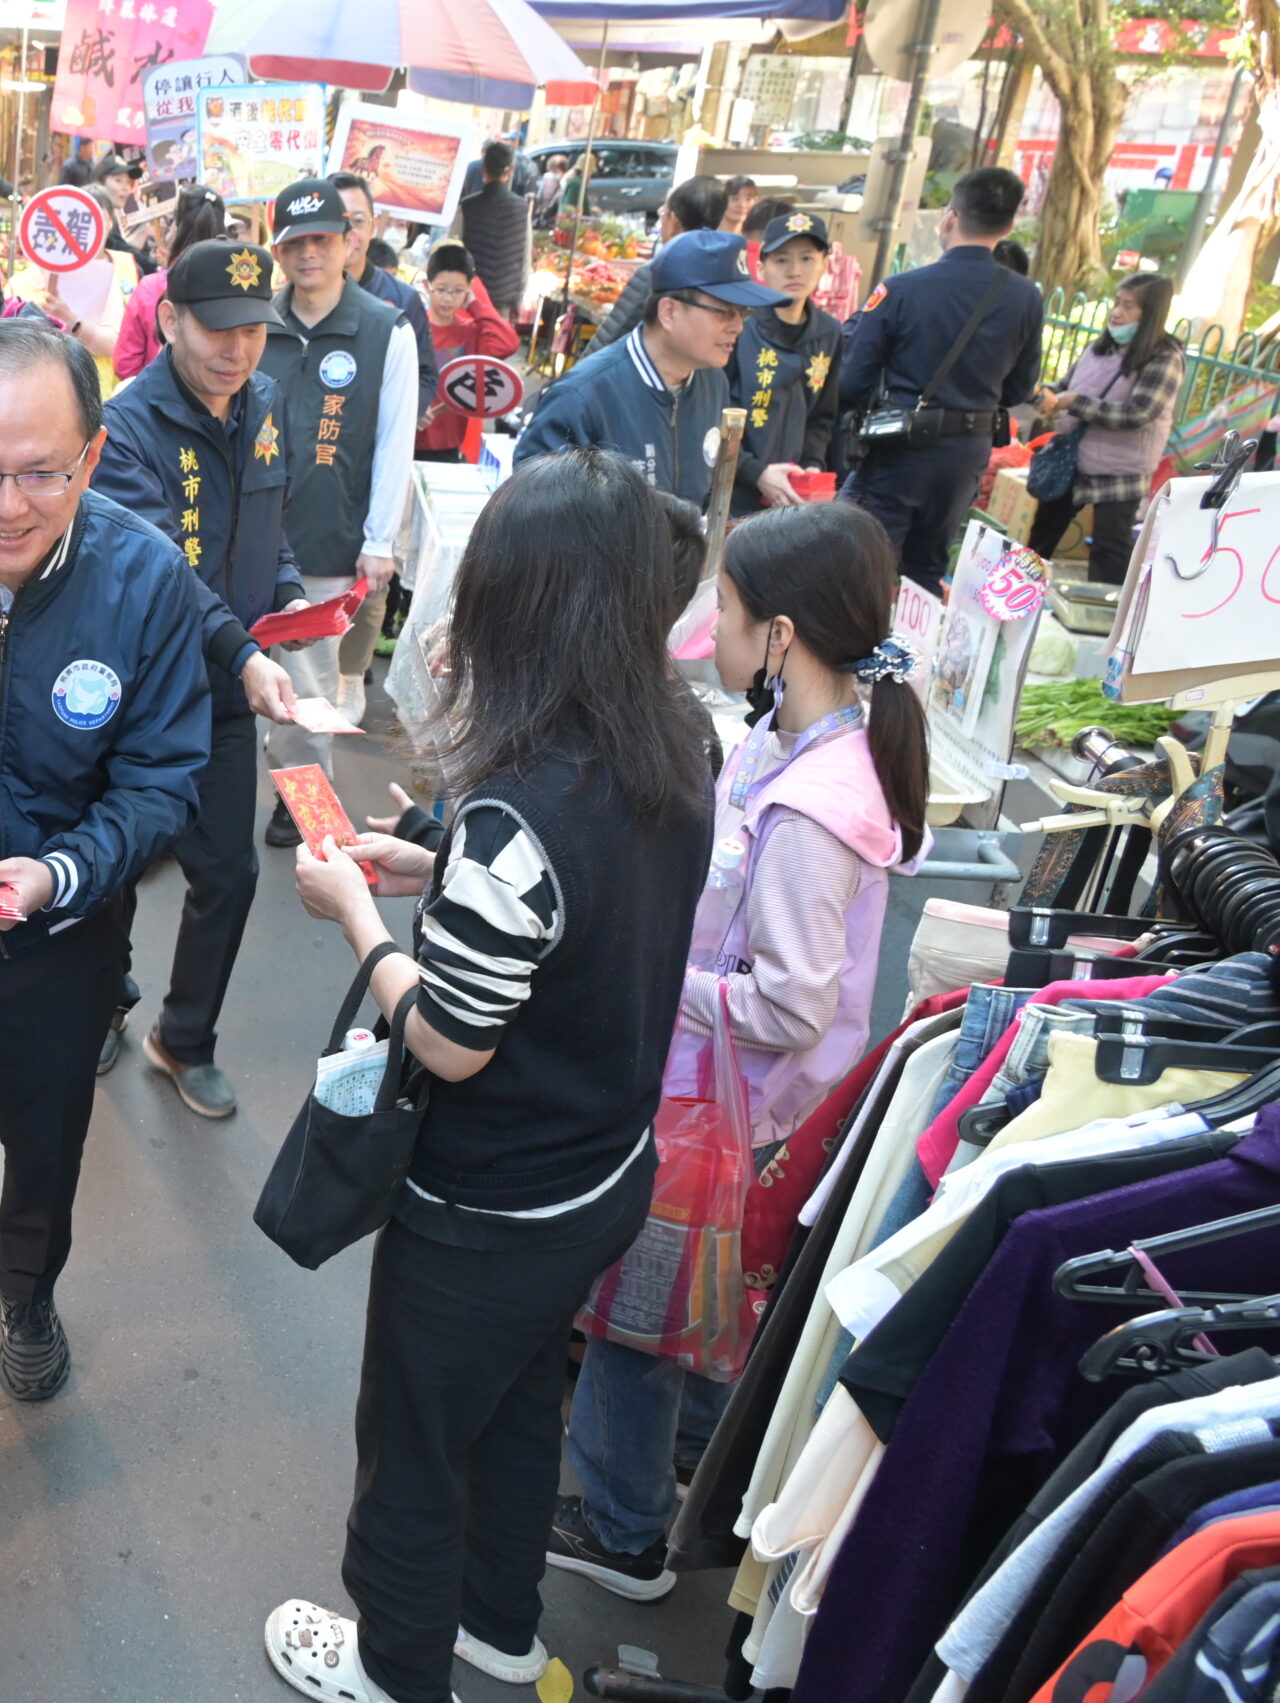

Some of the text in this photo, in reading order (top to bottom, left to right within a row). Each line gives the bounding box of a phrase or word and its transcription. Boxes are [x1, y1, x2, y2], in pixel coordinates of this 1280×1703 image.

[154, 68, 235, 96] 停讓行人
[750, 347, 778, 428] 桃市刑警
[315, 394, 346, 466] 家防官
[179, 447, 202, 567] 桃市刑警
[900, 587, 931, 638] 100
[988, 568, 1040, 612] 50
[69, 717, 87, 726] POLICE
[88, 701, 115, 725] DEPARTMENT
